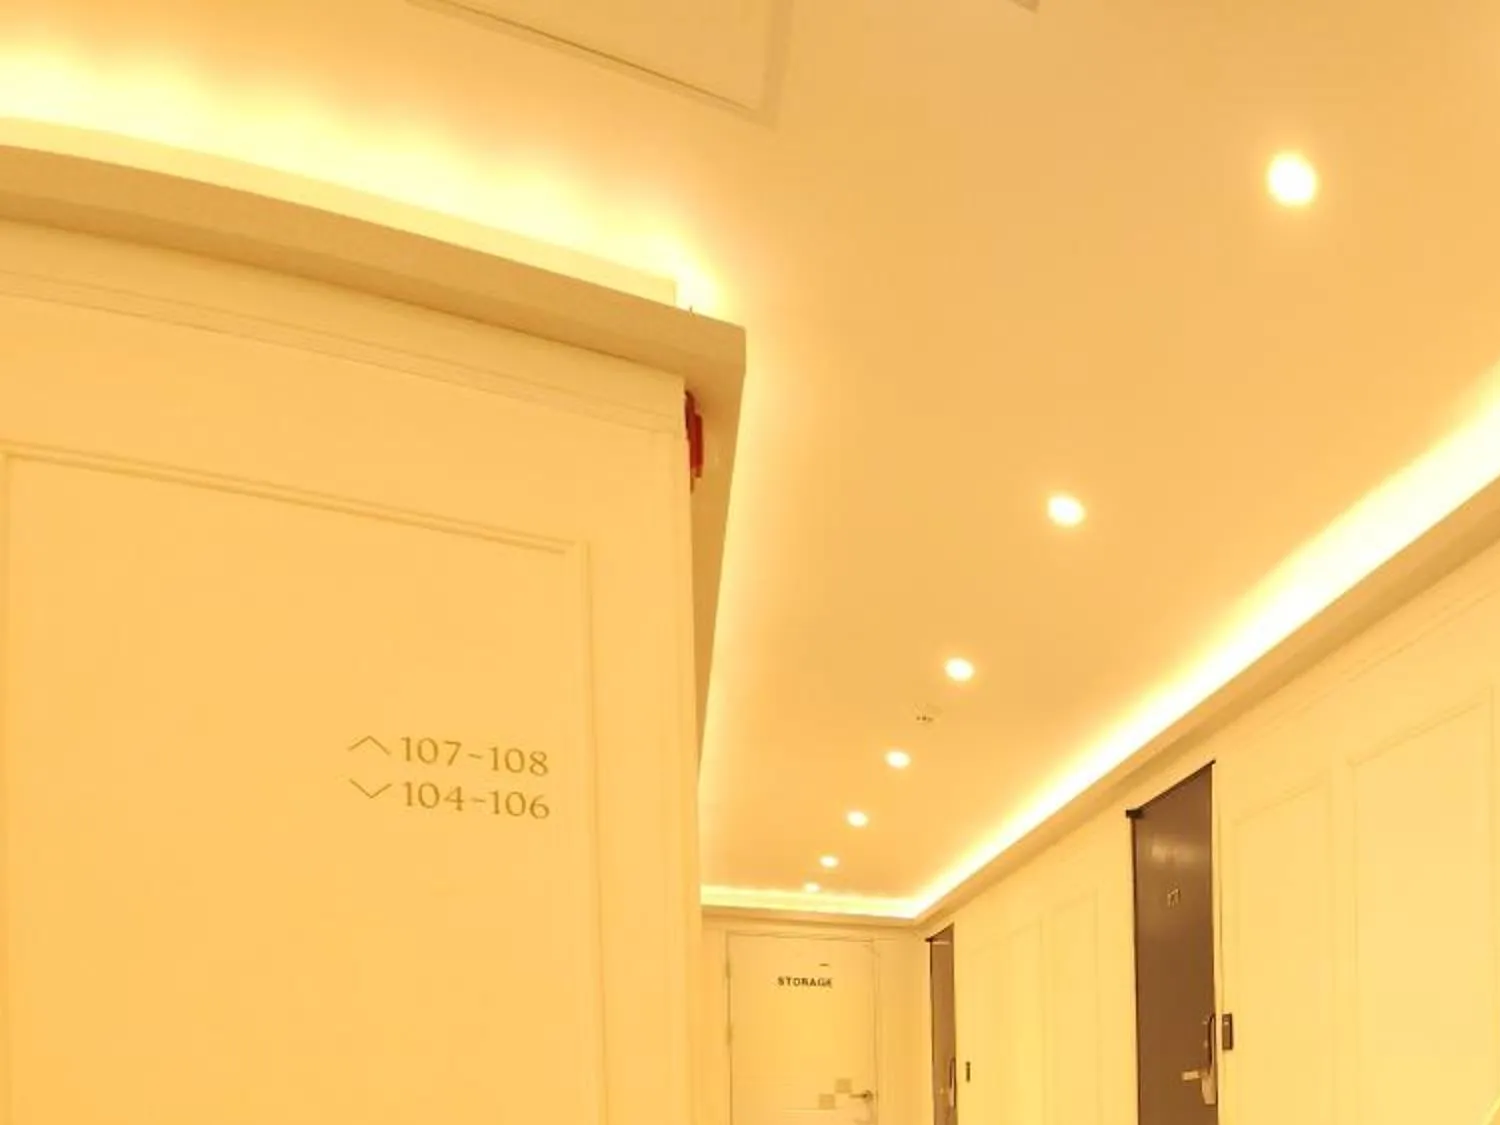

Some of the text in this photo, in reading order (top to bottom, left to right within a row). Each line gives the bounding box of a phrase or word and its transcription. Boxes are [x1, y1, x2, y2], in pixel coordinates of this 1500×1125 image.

[400, 735, 549, 777] 107-108
[402, 781, 550, 820] 104-106
[777, 975, 833, 988] STORAGE
